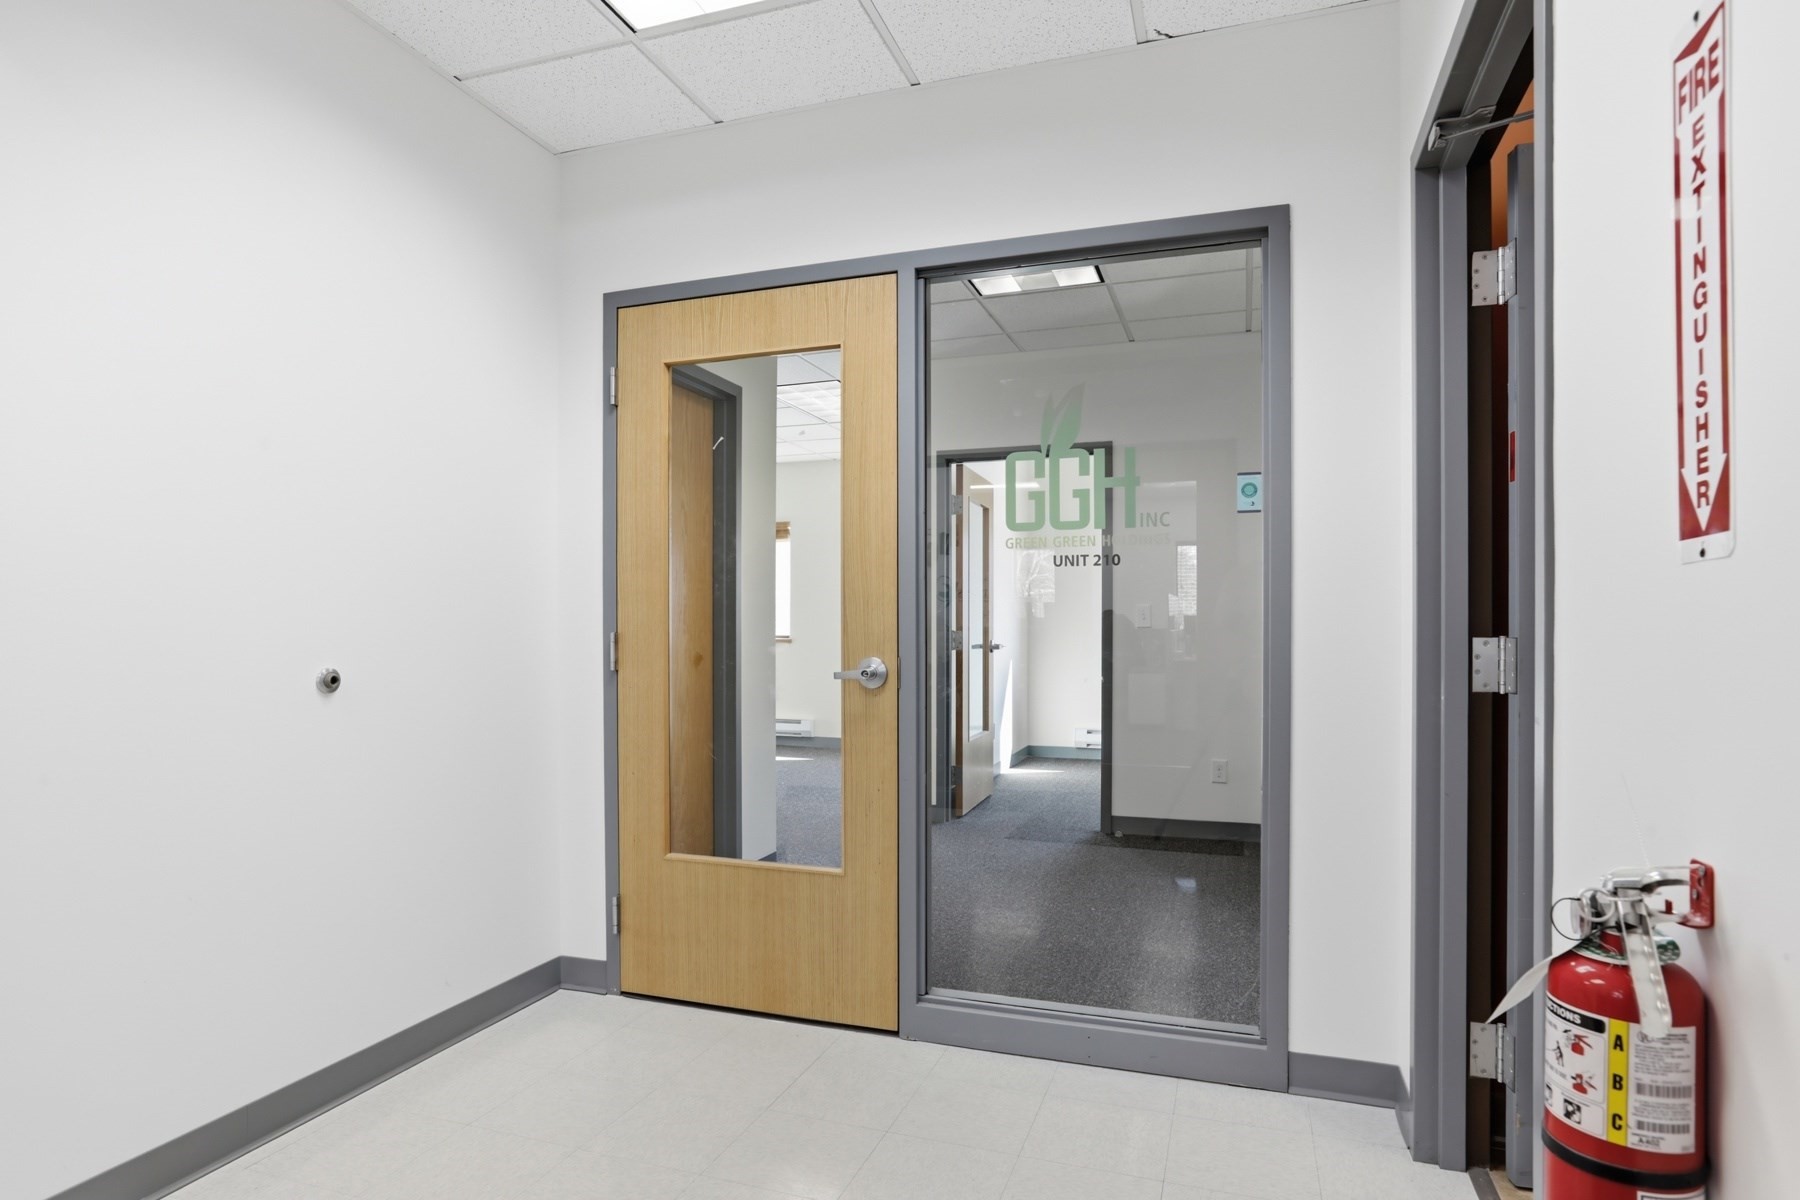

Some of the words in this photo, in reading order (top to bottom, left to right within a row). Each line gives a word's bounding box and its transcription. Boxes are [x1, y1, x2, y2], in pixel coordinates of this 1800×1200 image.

[1678, 37, 1720, 126] FIRE
[1690, 112, 1711, 509] EXTINGUISHER
[1005, 446, 1141, 532] GGH
[1139, 511, 1171, 528] INC
[1005, 535, 1048, 550] GREEN
[1053, 534, 1097, 549] GREEN
[1053, 554, 1090, 568] UNIT
[1093, 553, 1121, 567] 210
[1612, 1034, 1625, 1052] A
[1611, 1073, 1624, 1092] B
[1611, 1113, 1624, 1132] C
